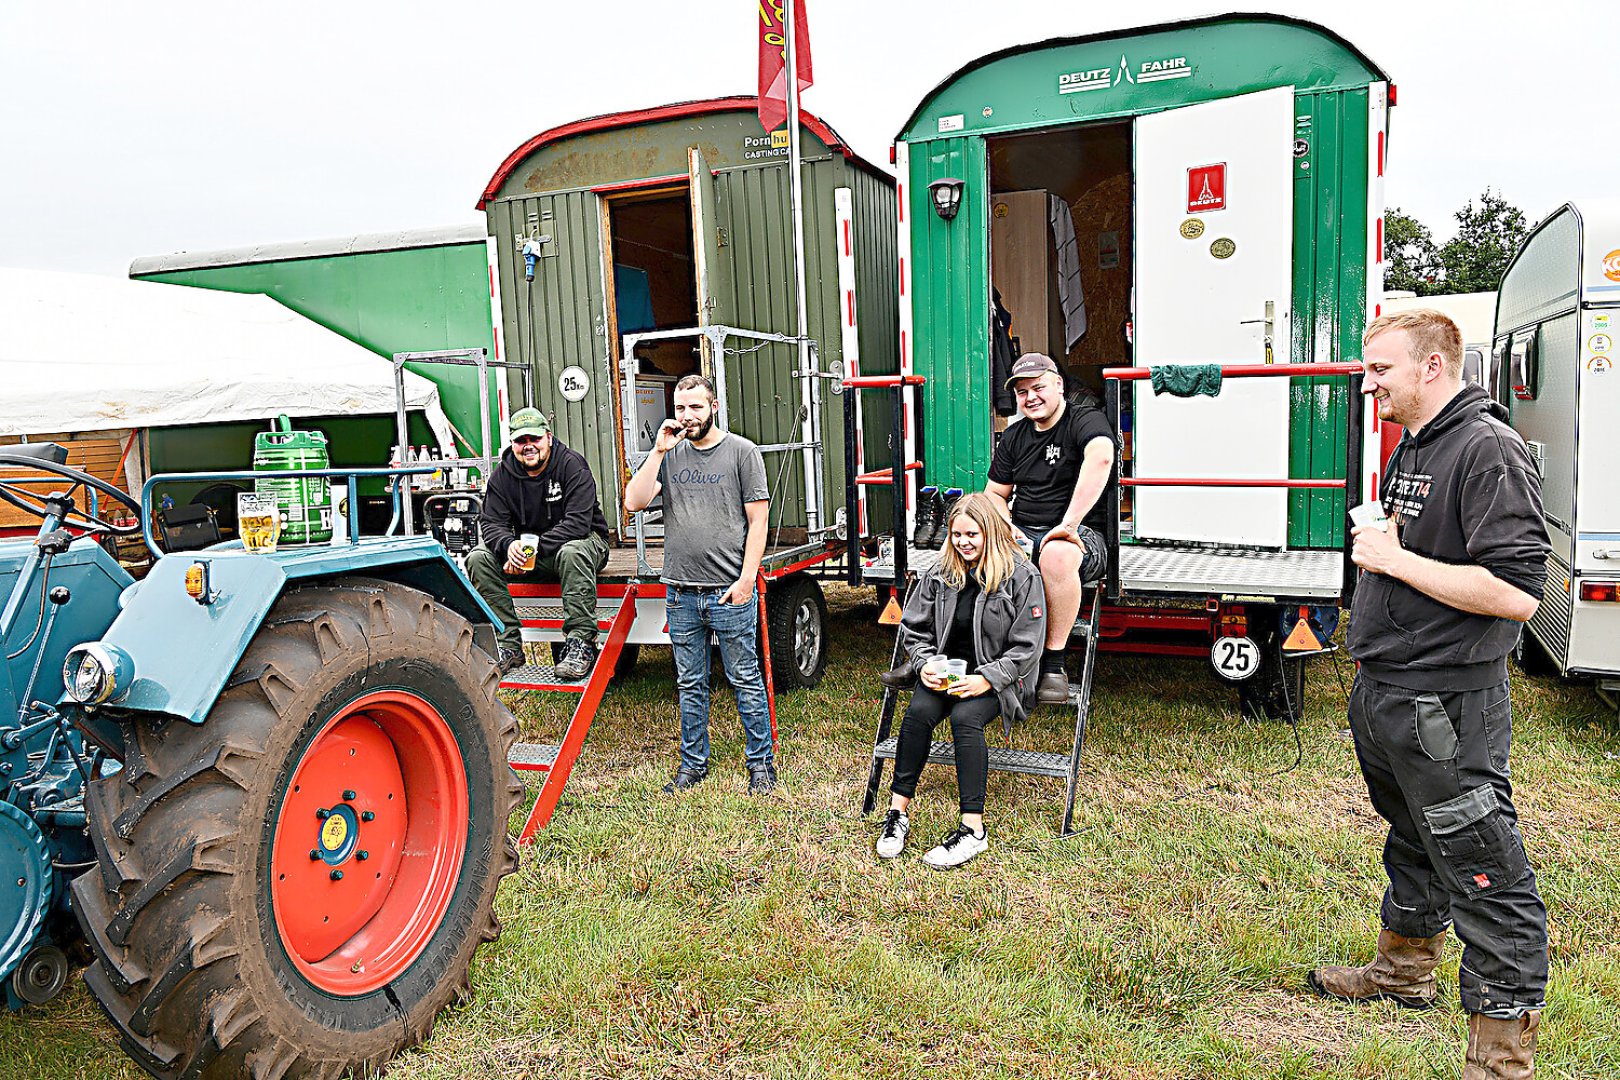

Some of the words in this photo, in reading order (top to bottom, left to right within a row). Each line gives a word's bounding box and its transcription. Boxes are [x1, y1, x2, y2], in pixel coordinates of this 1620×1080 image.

[1059, 67, 1111, 85] DEUTZ
[1141, 56, 1187, 73] FAHR
[744, 134, 788, 148] Pornhu
[744, 149, 780, 159] CASTING
[1190, 197, 1222, 207] DEUTZ
[564, 376, 577, 392] 25
[671, 467, 726, 485] s.Oliver
[1221, 641, 1250, 672] 25
[420, 857, 489, 993] ALLIANCE
